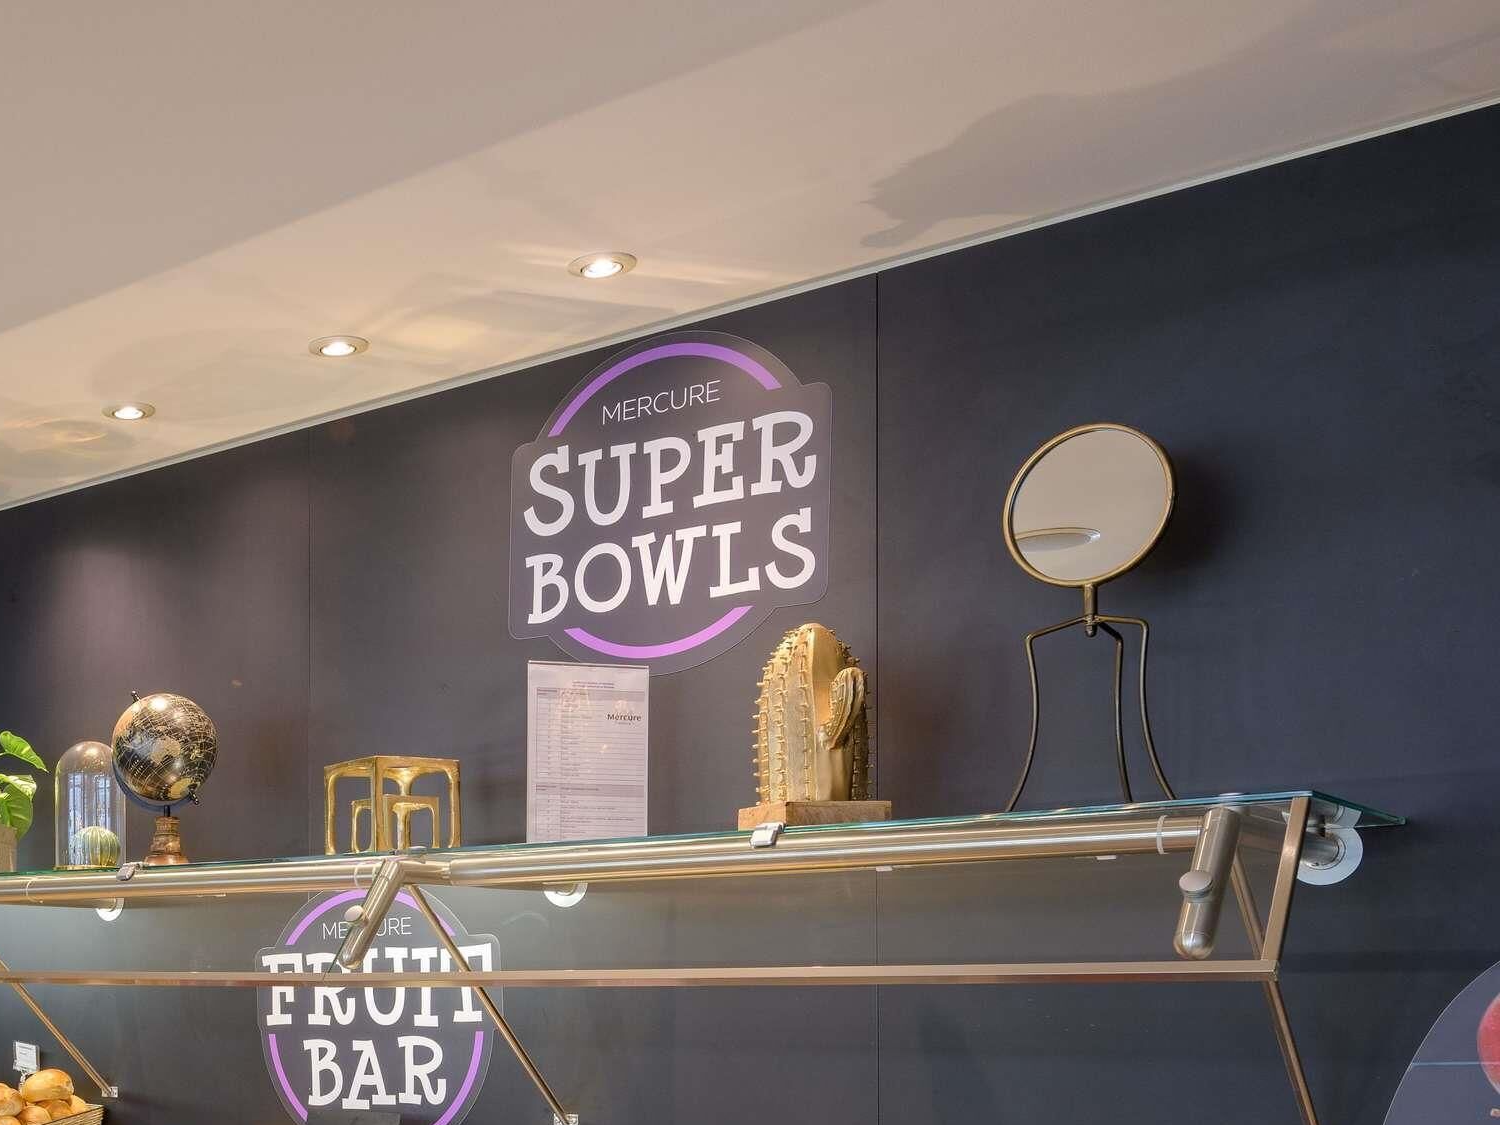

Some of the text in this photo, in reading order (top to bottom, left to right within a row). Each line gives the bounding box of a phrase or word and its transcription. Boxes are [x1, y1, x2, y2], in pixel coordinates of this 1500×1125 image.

[601, 379, 722, 425] MERCURE
[523, 410, 817, 537] SUPER
[525, 507, 816, 624] BOWLS
[322, 916, 412, 939] MEURE
[262, 943, 493, 1027] FRUIT
[303, 1035, 447, 1110] BAR
